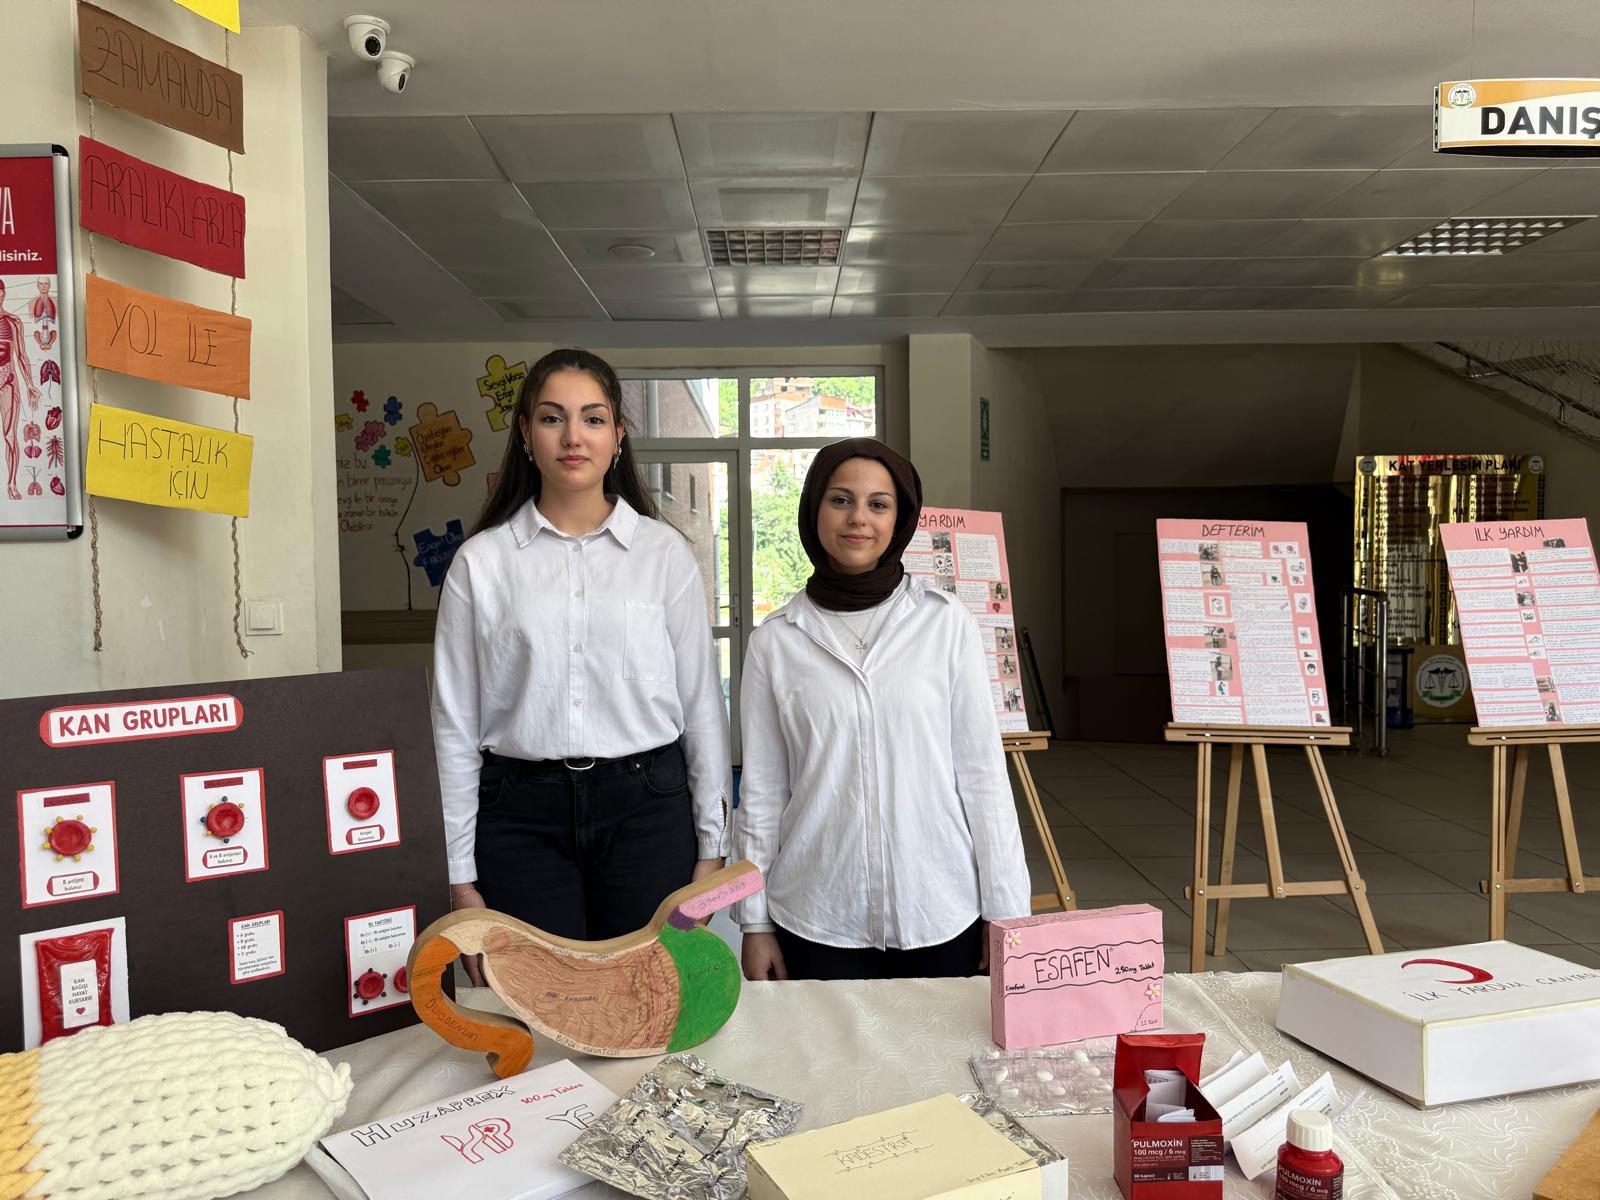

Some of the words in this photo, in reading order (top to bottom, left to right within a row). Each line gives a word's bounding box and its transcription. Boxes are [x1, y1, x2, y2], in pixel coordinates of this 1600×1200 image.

[1480, 106, 1600, 139] DANIŞ
[106, 298, 163, 357] YOL
[98, 419, 229, 468] HASTALIK
[1389, 461, 1414, 471] KAT
[169, 465, 209, 500] İÇİN
[919, 514, 966, 528] YARDIM
[1202, 523, 1265, 538] DEFTERİM
[1474, 526, 1493, 542] İLK
[1498, 526, 1545, 540] YARDIM
[59, 713, 111, 738] KAN
[123, 702, 230, 730] GRUPLARI
[1034, 948, 1111, 984] ESAFEN
[72, 989, 88, 998] HAYAT
[520, 1094, 541, 1104] 100
[350, 1085, 515, 1147] HUZAPREX
[1133, 1138, 1183, 1148] PULMOXİN
[1148, 1149, 1164, 1157] mcg
[1278, 1165, 1322, 1186] PULMOXİN
